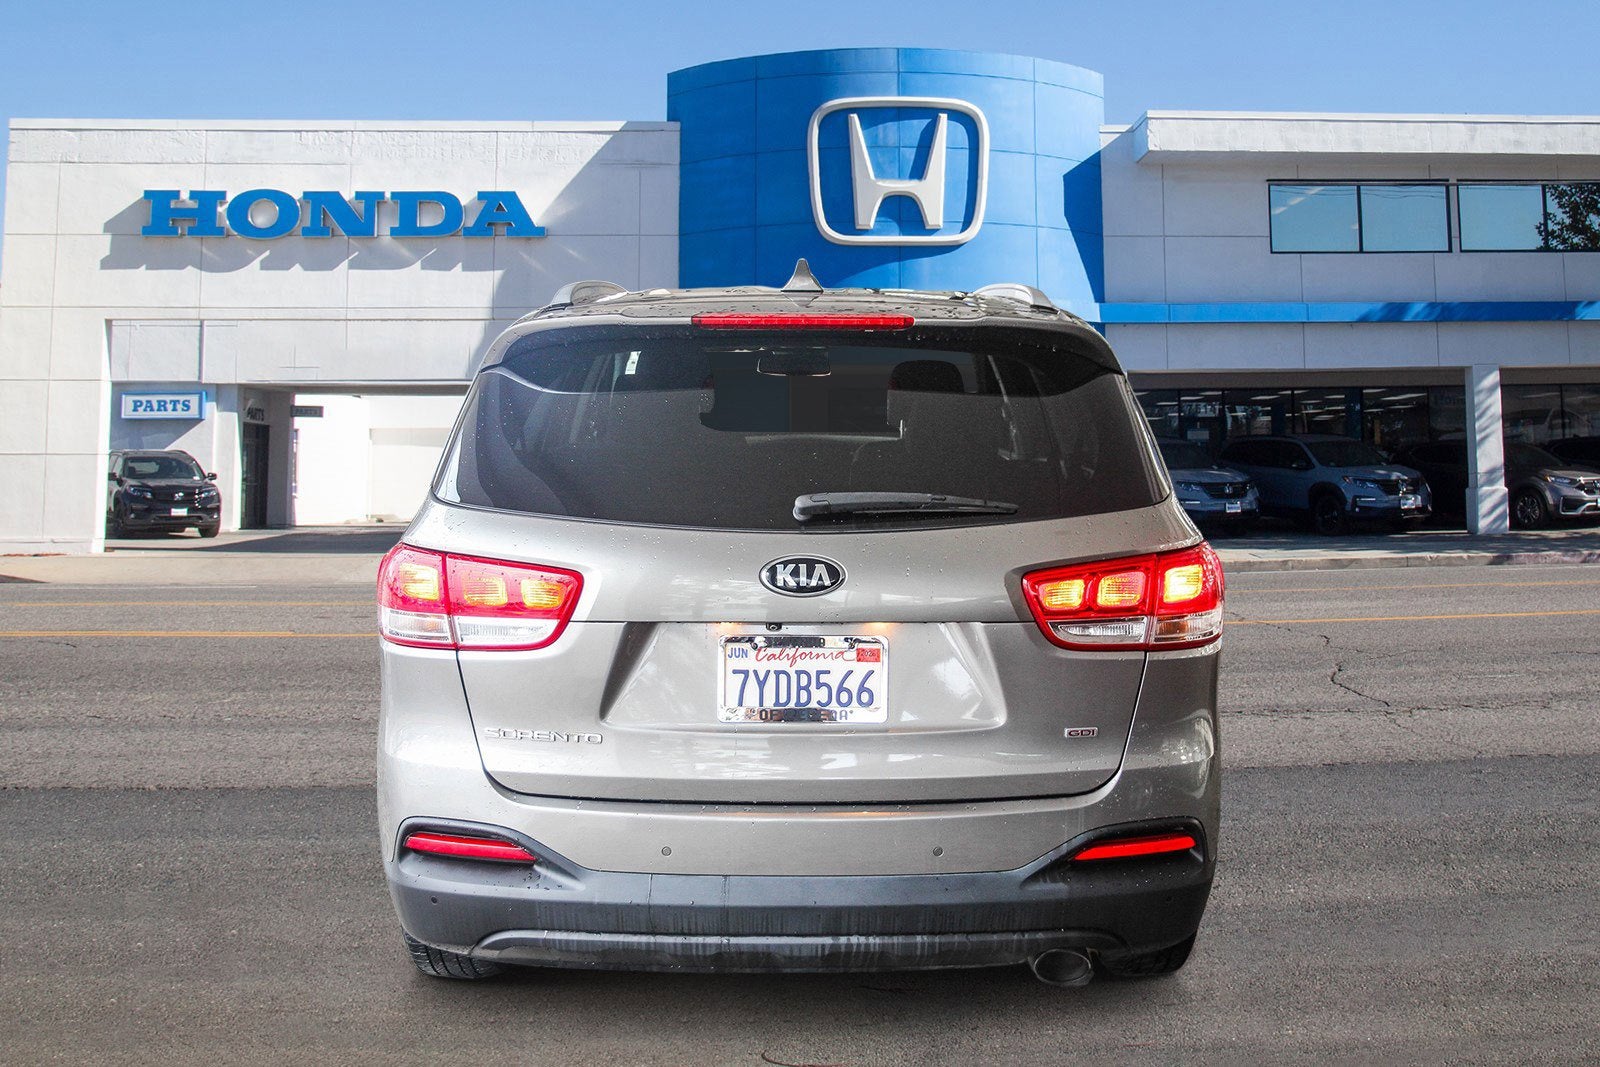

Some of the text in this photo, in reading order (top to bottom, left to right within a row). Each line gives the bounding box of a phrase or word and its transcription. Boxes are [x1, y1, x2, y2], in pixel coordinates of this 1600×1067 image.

[141, 188, 547, 239] HONDA
[131, 399, 191, 412] PARTS
[775, 563, 832, 587] KIA
[727, 647, 748, 659] JUN
[755, 647, 849, 667] California
[732, 669, 875, 708] 7YDB566
[484, 727, 603, 744] SORENTO
